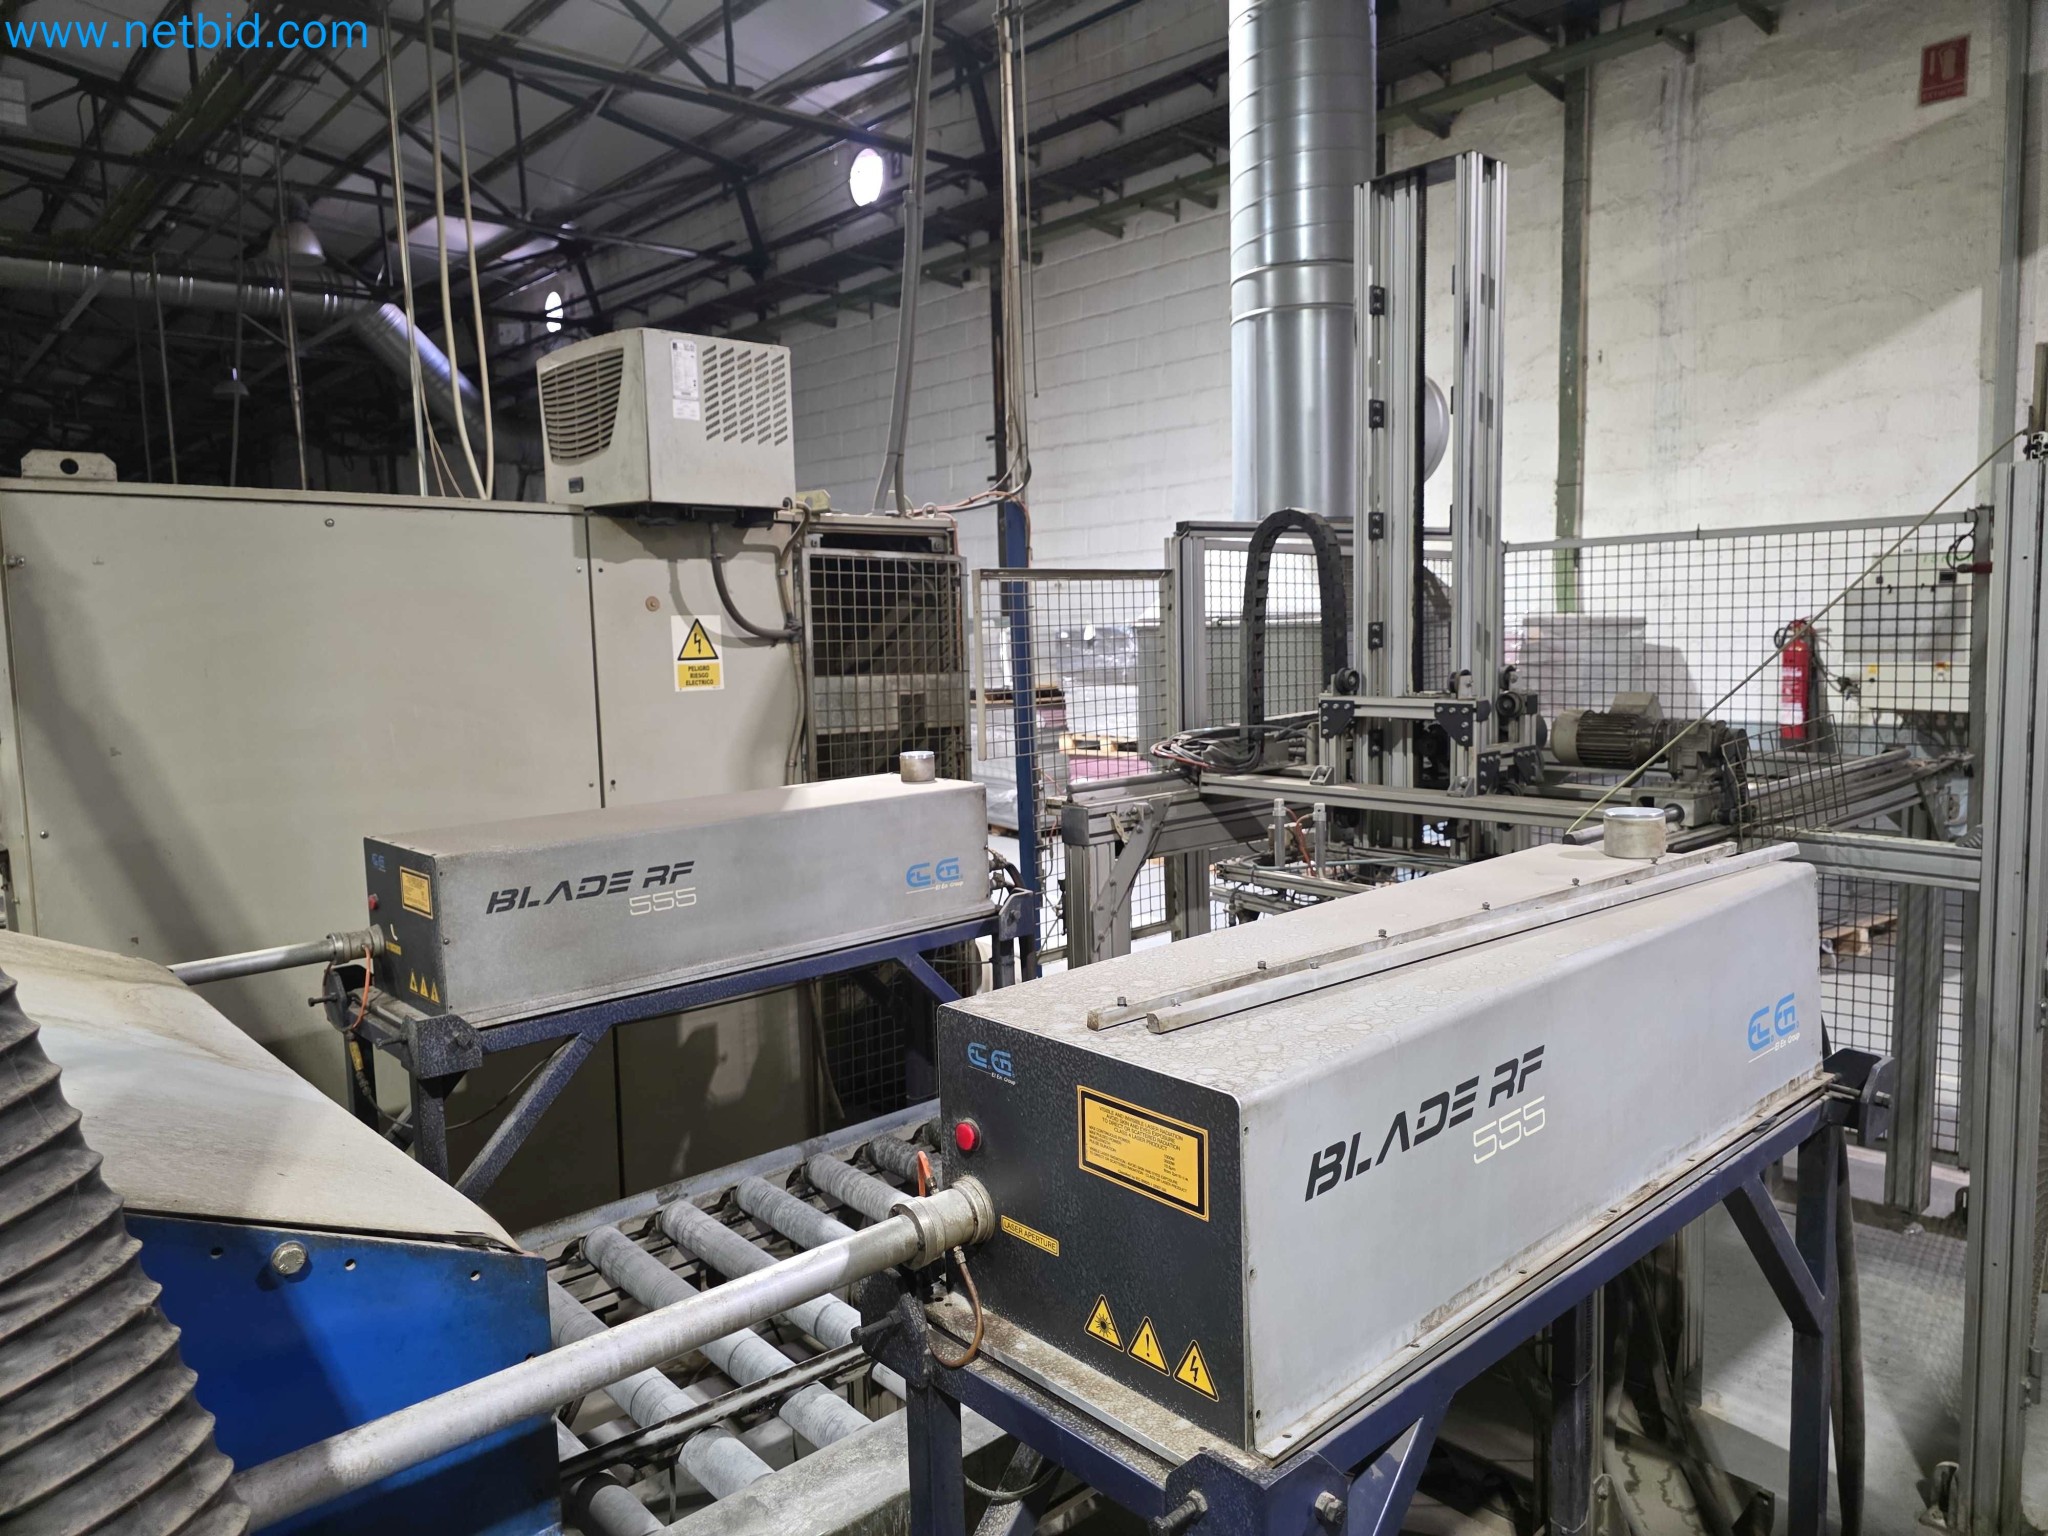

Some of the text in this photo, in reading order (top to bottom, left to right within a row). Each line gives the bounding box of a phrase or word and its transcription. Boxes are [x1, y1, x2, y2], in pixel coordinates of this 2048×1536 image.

[486, 861, 695, 914] BLADE RF
[629, 887, 697, 915] 555
[1109, 1120, 1123, 1129] DIRECT
[1157, 1138, 1180, 1151] RADIATION
[1145, 1123, 1158, 1132] LASER
[1304, 1045, 1545, 1203] BLADE RF
[1472, 1096, 1546, 1165] 555
[1132, 1134, 1145, 1143] LASER
[1146, 1139, 1167, 1151] PRODUCT
[1003, 1220, 1056, 1251] LASER APERTURE
